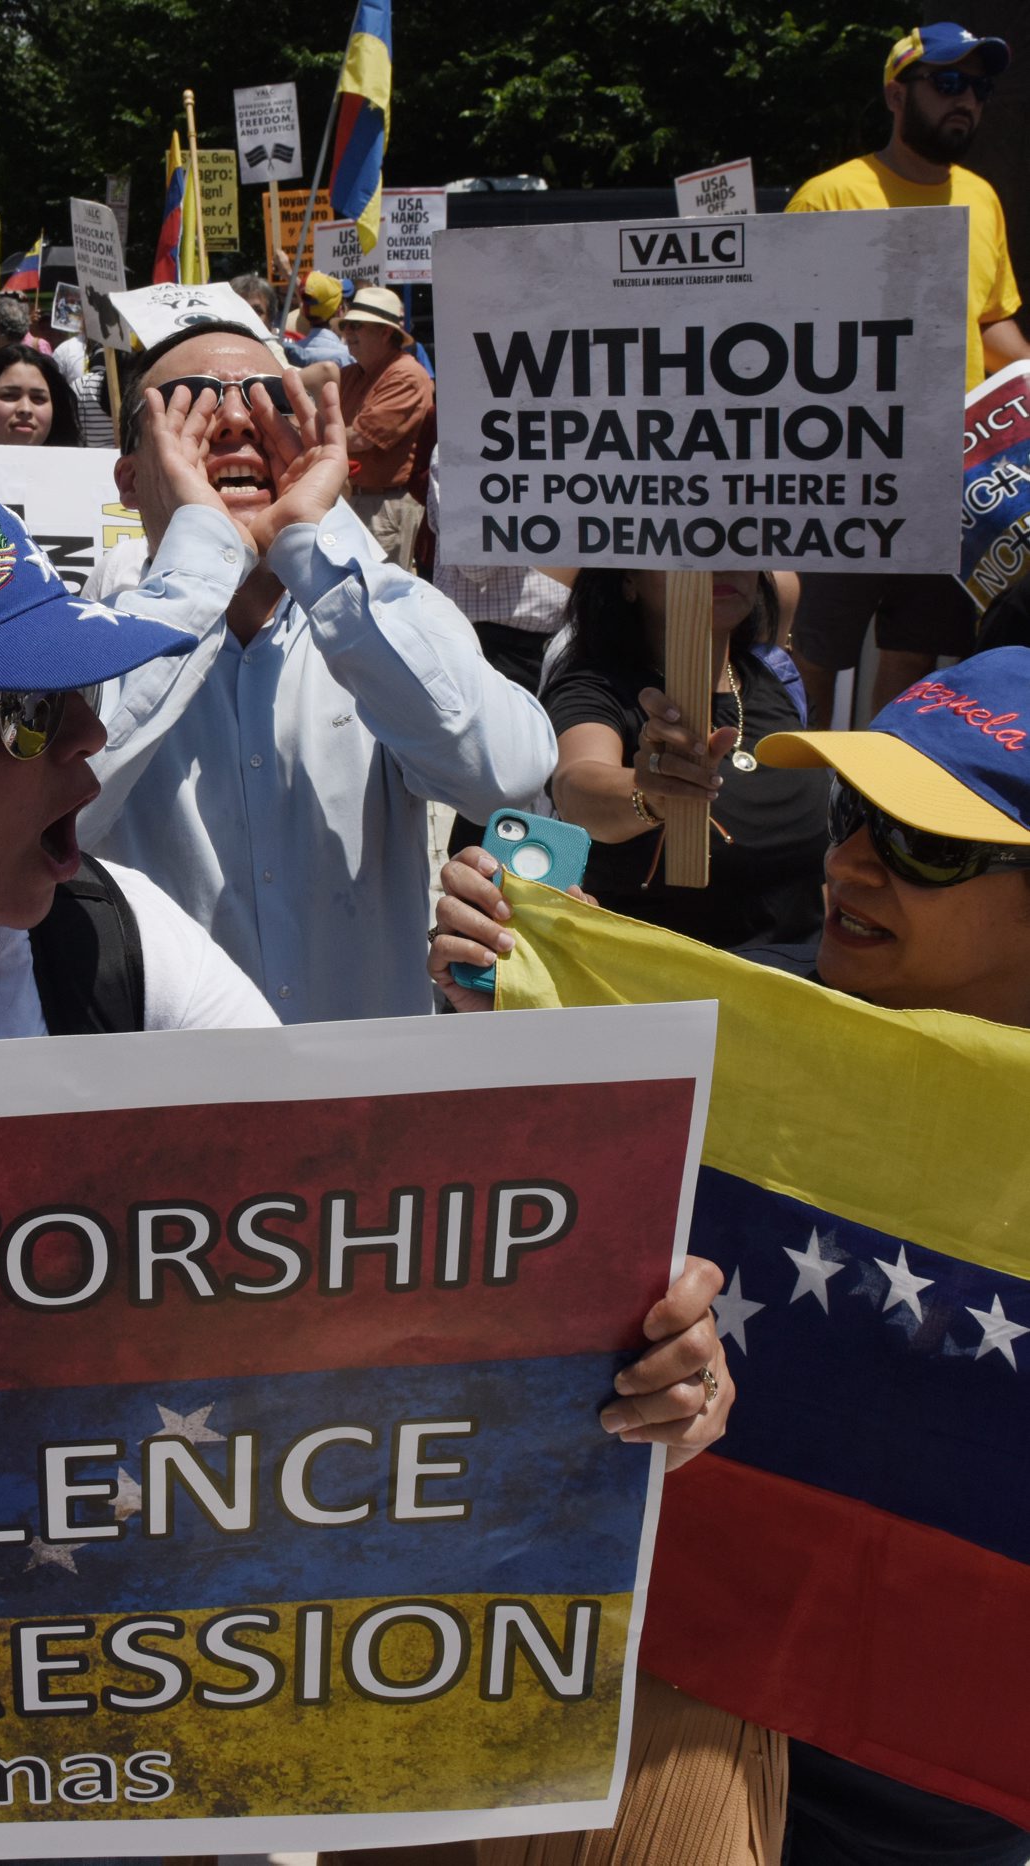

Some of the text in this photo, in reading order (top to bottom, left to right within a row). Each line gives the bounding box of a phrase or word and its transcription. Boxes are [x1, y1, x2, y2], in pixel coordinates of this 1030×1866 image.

[240, 124, 295, 137] AND JUSTICE
[211, 152, 234, 163] Gen.
[701, 175, 728, 193] USA
[201, 184, 223, 199] ign!
[695, 186, 736, 207] HANDS
[219, 203, 232, 216] of
[397, 198, 424, 211] USA
[707, 200, 726, 214] OFF
[391, 211, 430, 224] HANDS
[401, 224, 419, 234] OFF
[387, 236, 432, 247] OLIVARIA
[629, 230, 736, 265] VALC
[332, 245, 363, 258] HAND
[387, 249, 431, 261] ENEZUEL
[92, 257, 118, 271] JUSTICE
[343, 256, 362, 268] OFF
[612, 273, 753, 288] VENEZUELAN AMERICAN LEADERSHIP COUNCIL
[160, 299, 210, 310] YA
[472, 319, 914, 399] WITHOUT
[479, 405, 904, 462] SEPARATION
[479, 472, 898, 507] OF POWERS THERE IS
[482, 514, 907, 559] NO DEMOCRACY
